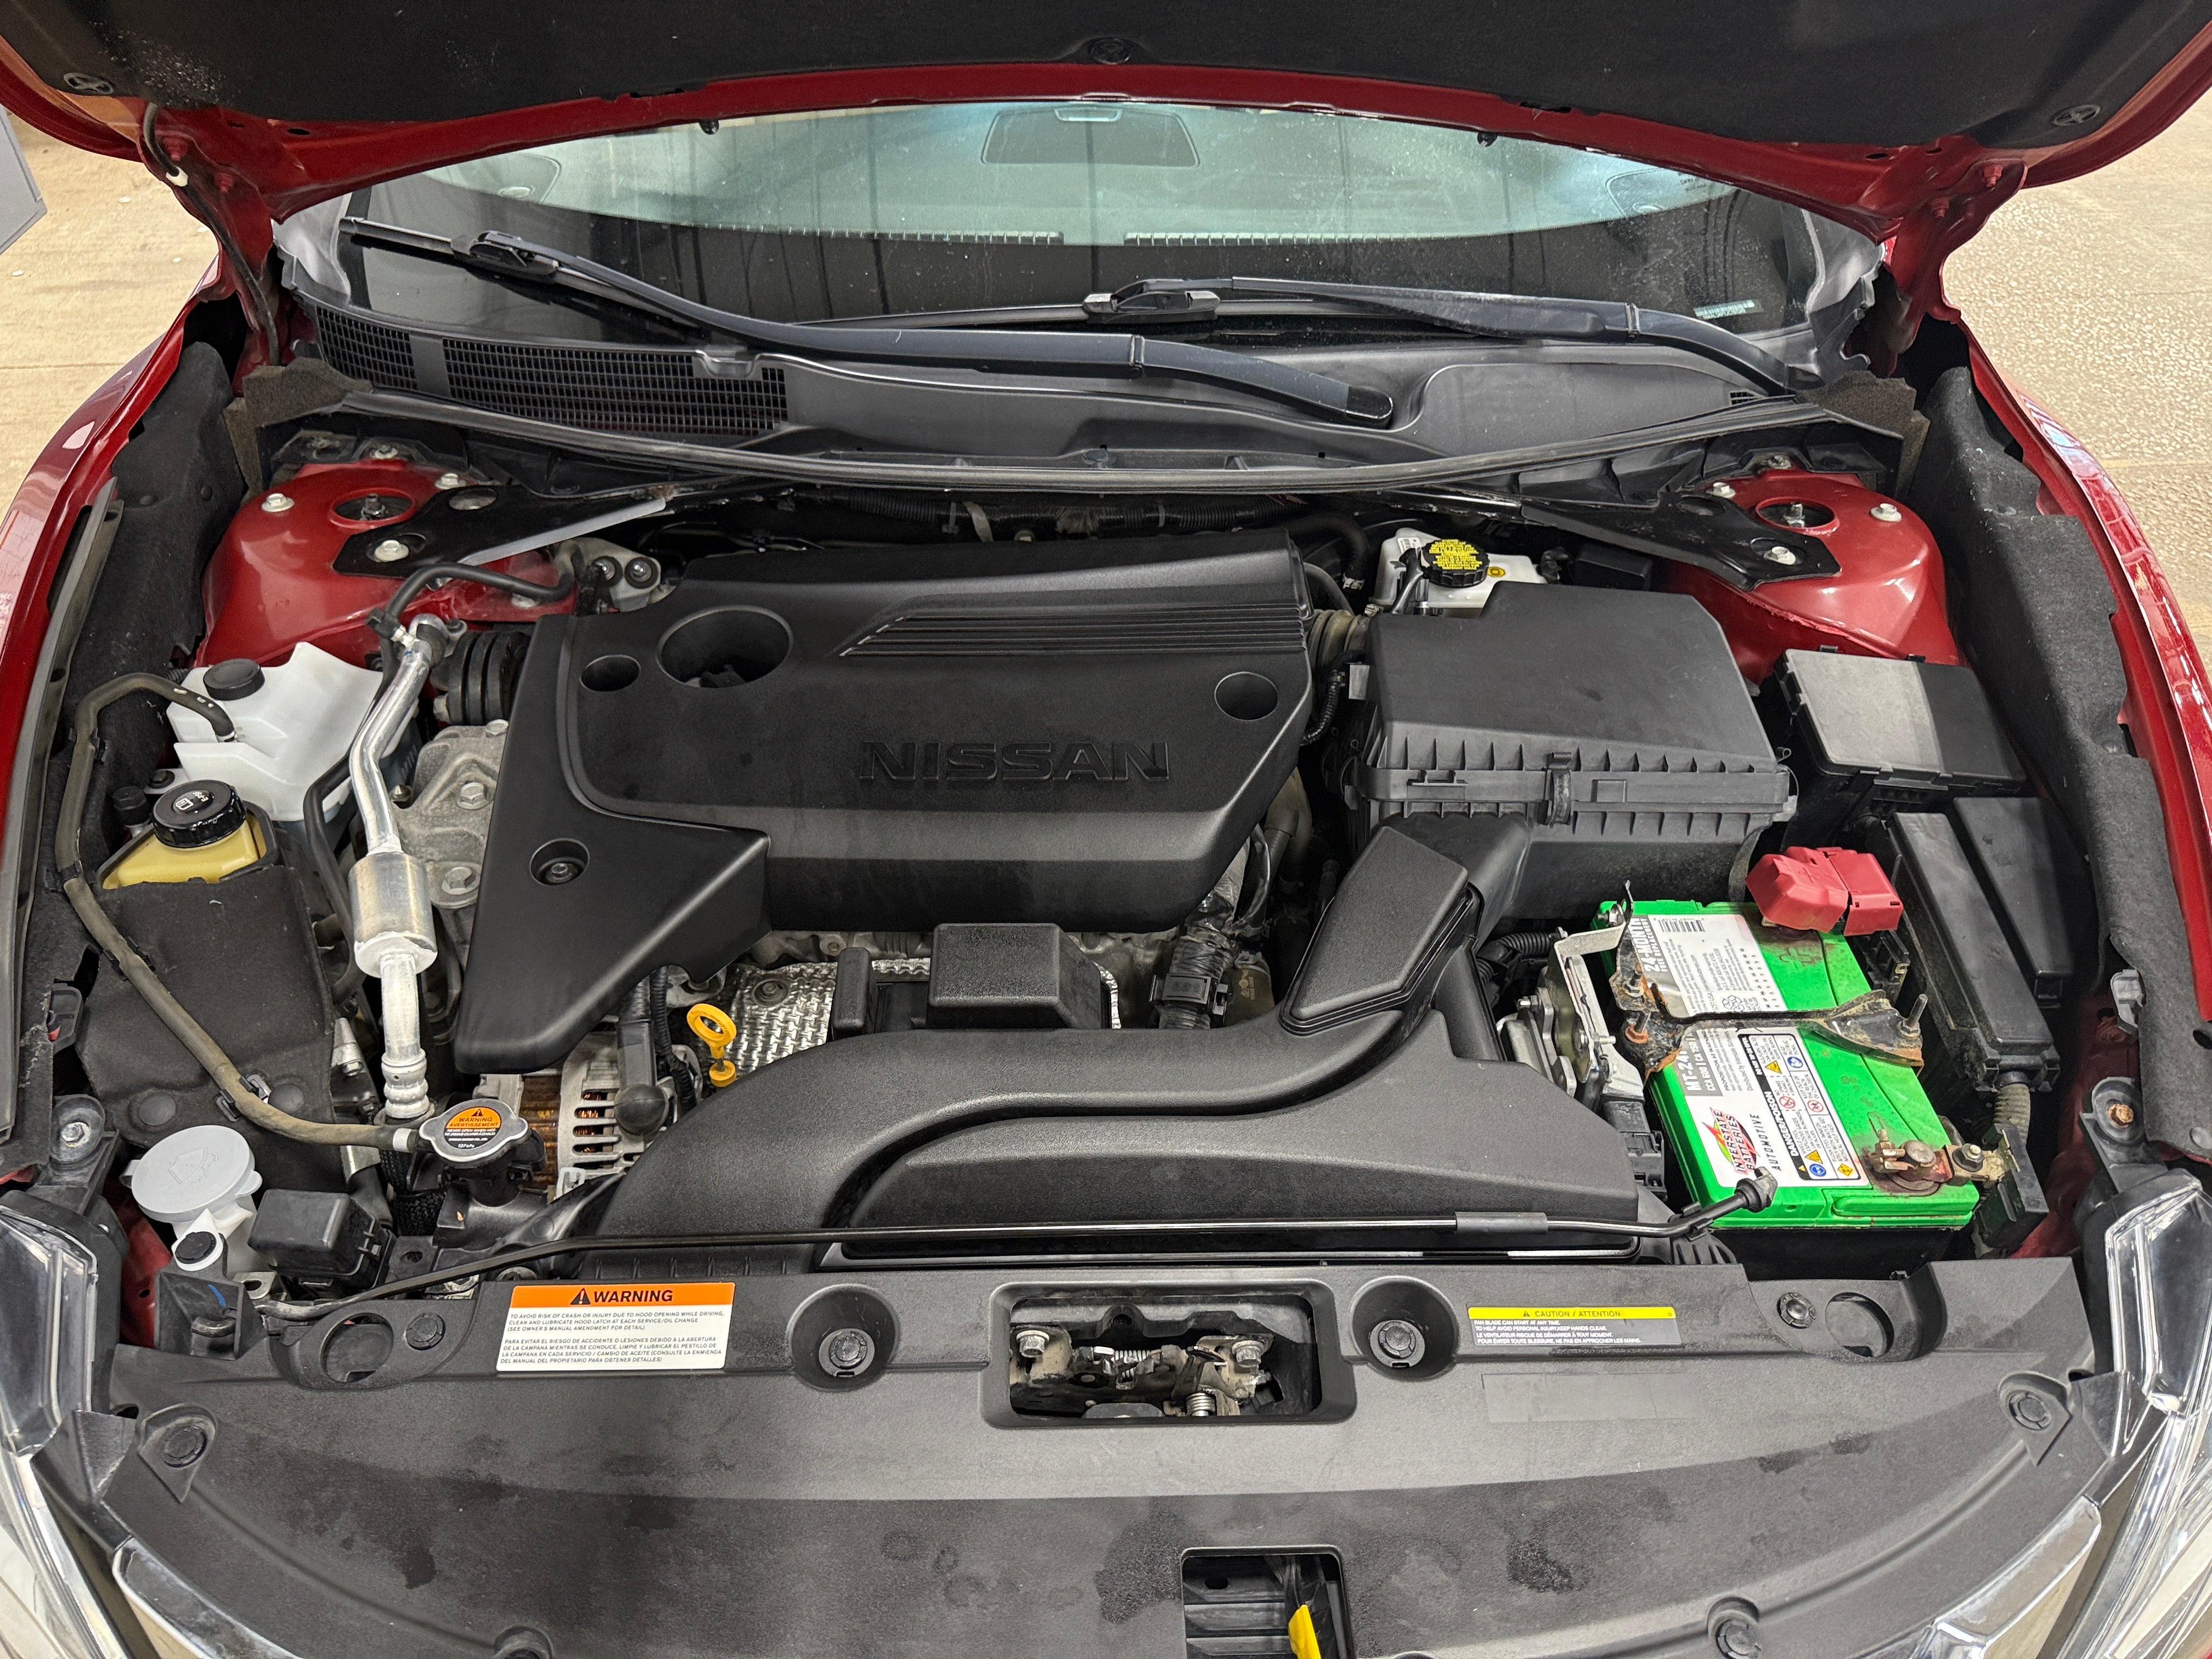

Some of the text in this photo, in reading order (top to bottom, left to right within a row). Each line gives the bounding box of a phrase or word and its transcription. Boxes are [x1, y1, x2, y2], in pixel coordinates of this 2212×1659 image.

[859, 742, 1170, 781] NISSAN
[1630, 918, 1658, 971] 24-MONTH
[1640, 918, 1668, 972] FREE REPLACEMENT
[1697, 1066, 1711, 1078] 600
[1703, 1079, 1716, 1091] CCA
[1713, 1110, 1746, 1172] INTERSTATE
[1725, 1115, 1755, 1170] BATTERIES
[1748, 1114, 1782, 1171] AUTOMOTIVE
[1763, 1091, 1799, 1156] DANGER/POISON
[594, 1290, 674, 1303] WARNING
